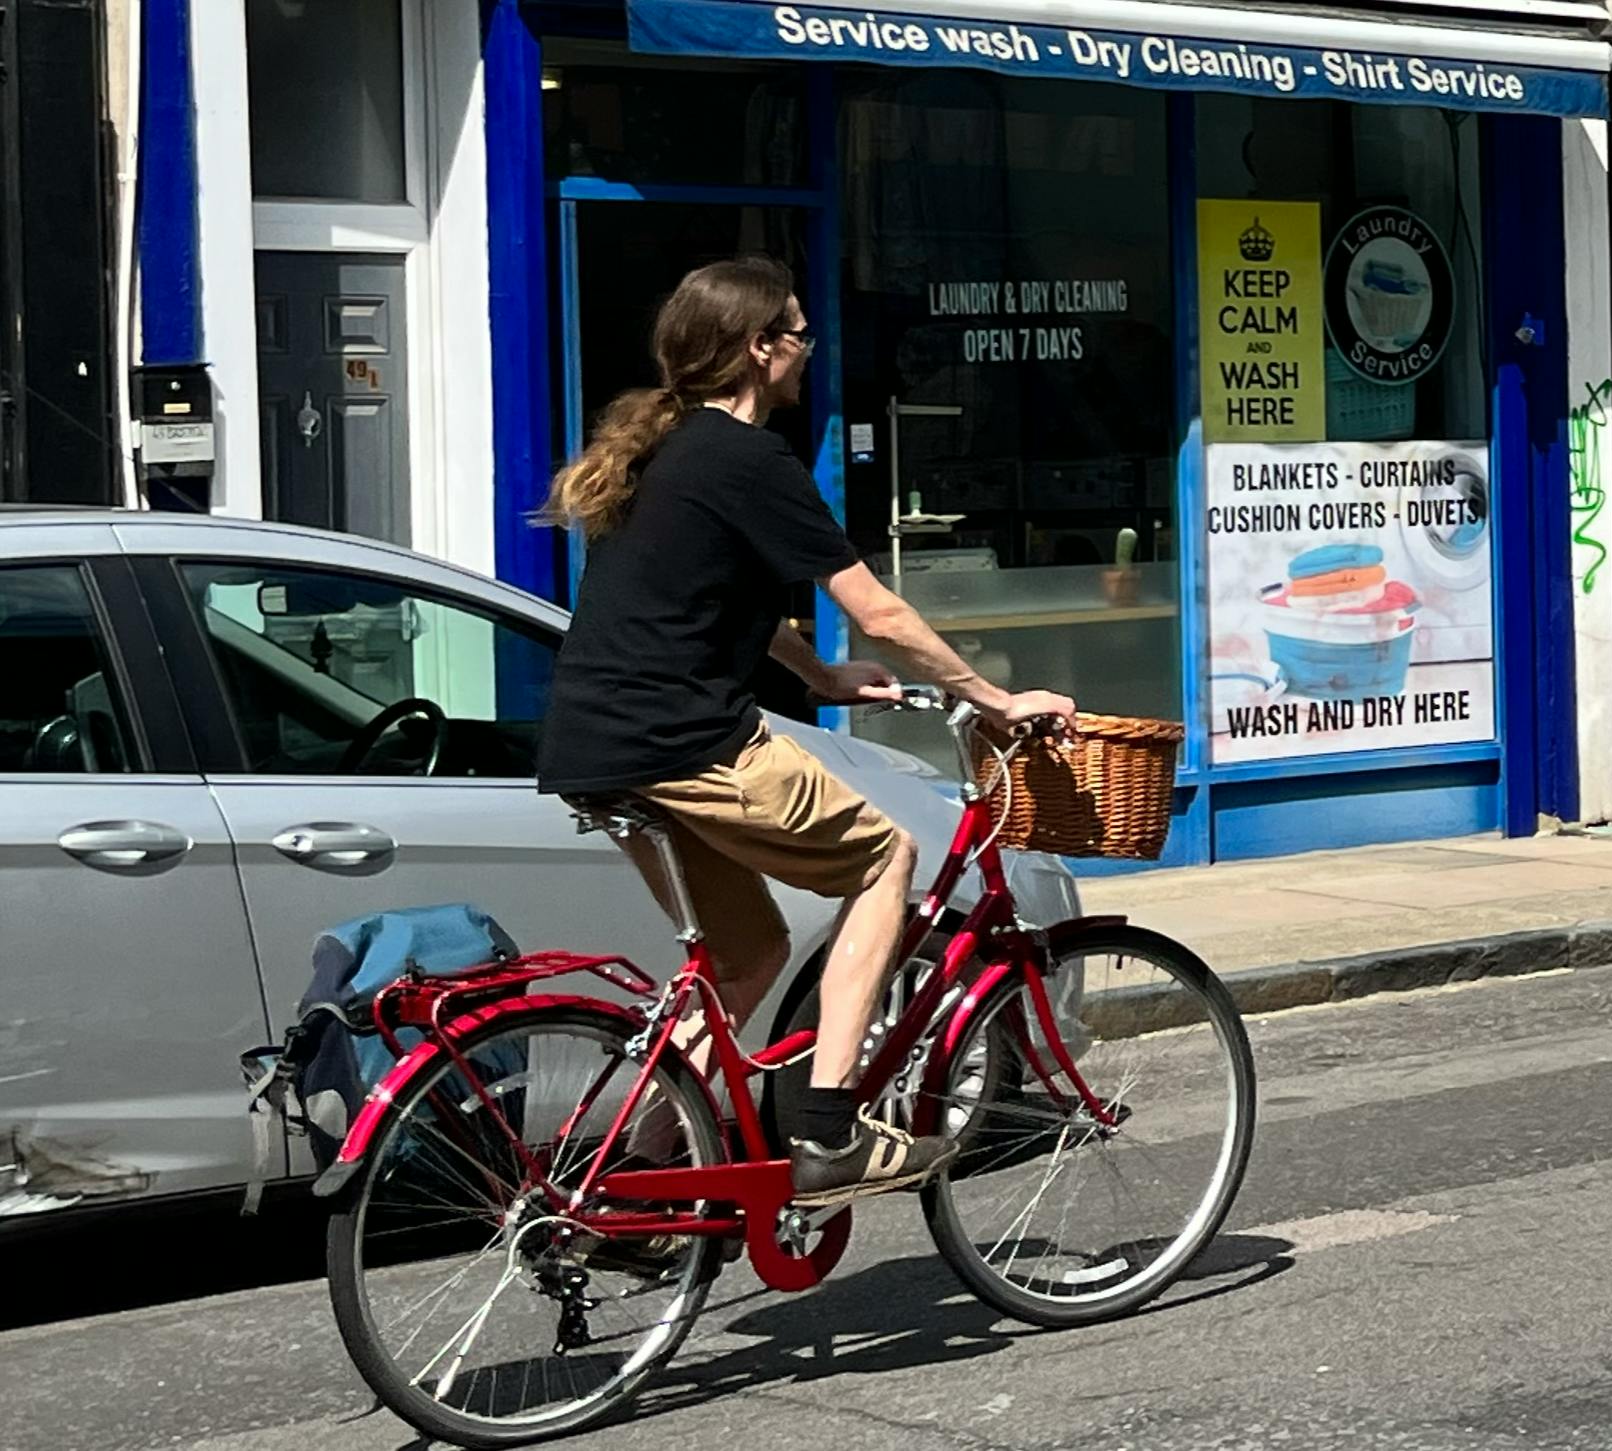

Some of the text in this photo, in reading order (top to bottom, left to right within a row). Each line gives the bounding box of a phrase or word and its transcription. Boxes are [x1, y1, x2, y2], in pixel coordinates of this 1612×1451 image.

[774, 6, 1524, 100] Service wash - Dry Cleaning - Shirt Service
[1341, 216, 1433, 255] Laundry
[929, 279, 1128, 315] LAUNDRY & DRY CLEANING
[1223, 269, 1291, 299] KEEP
[1218, 305, 1299, 335] CALM
[963, 326, 1084, 363] OPEN 7 DAYS
[1246, 341, 1273, 355] AND
[1350, 340, 1433, 378] Service
[346, 360, 367, 379] 49
[1219, 361, 1299, 390] WASH
[1226, 397, 1295, 426] HERE
[1233, 462, 1339, 492] BLANKETS
[1360, 459, 1456, 488] CURTAINS
[1207, 503, 1302, 535] CUSHION
[1308, 500, 1386, 530] COVERS
[1407, 496, 1481, 526] DUVETS
[1227, 690, 1470, 739] WASH AND DRY HERE
